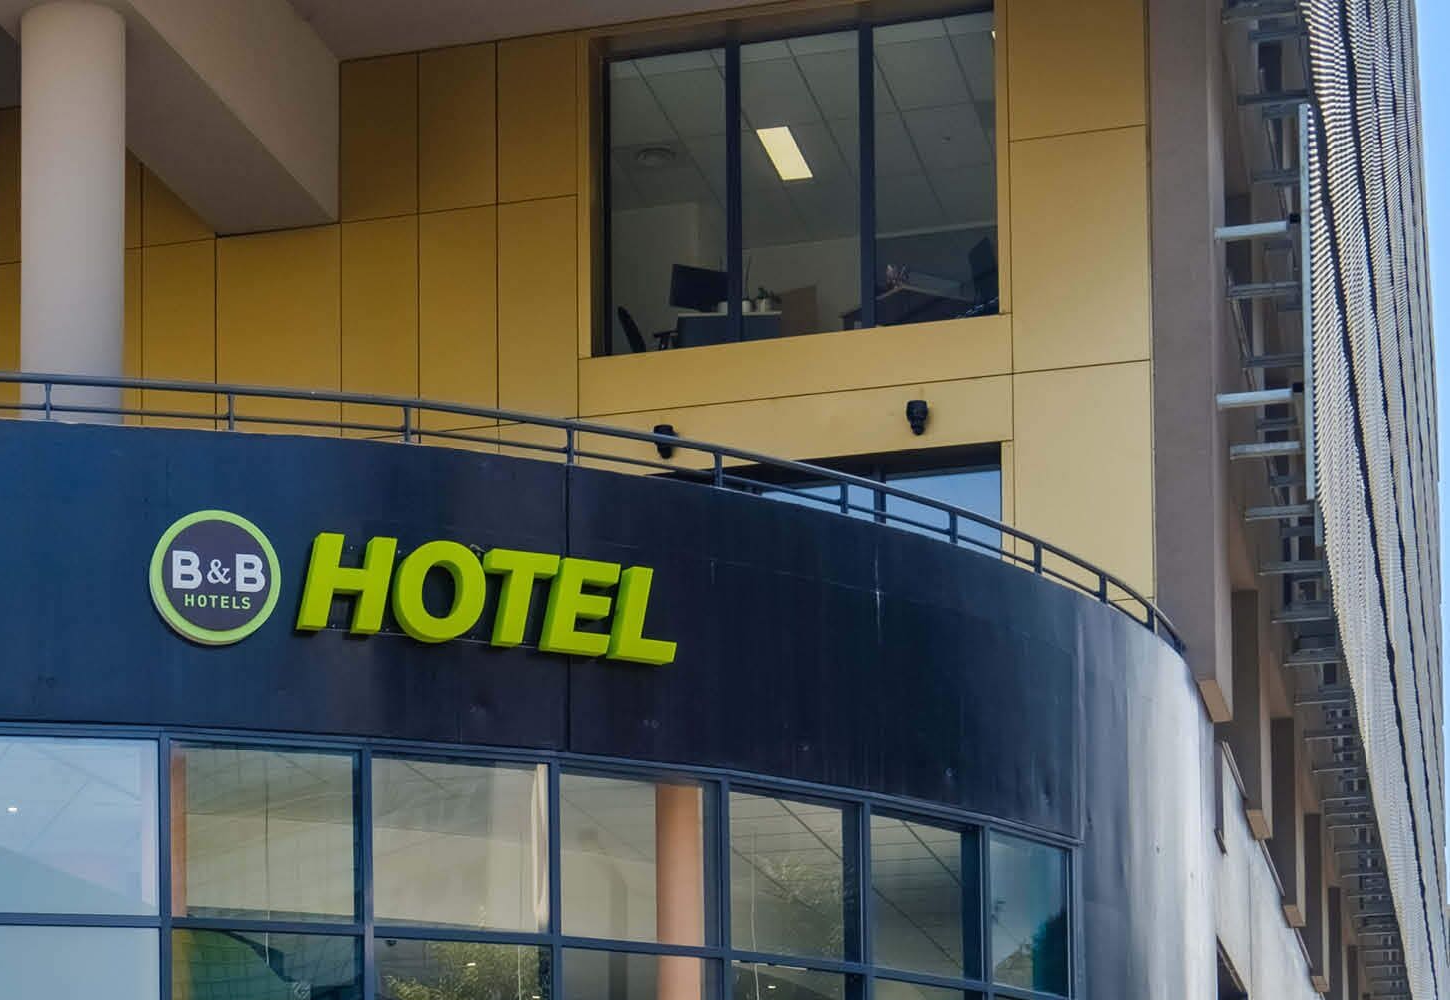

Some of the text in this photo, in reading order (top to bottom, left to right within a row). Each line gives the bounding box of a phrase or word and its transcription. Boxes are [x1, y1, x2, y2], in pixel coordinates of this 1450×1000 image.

[172, 550, 266, 593] B&B
[184, 594, 252, 610] HOTELS
[296, 532, 677, 665] HOTEL
